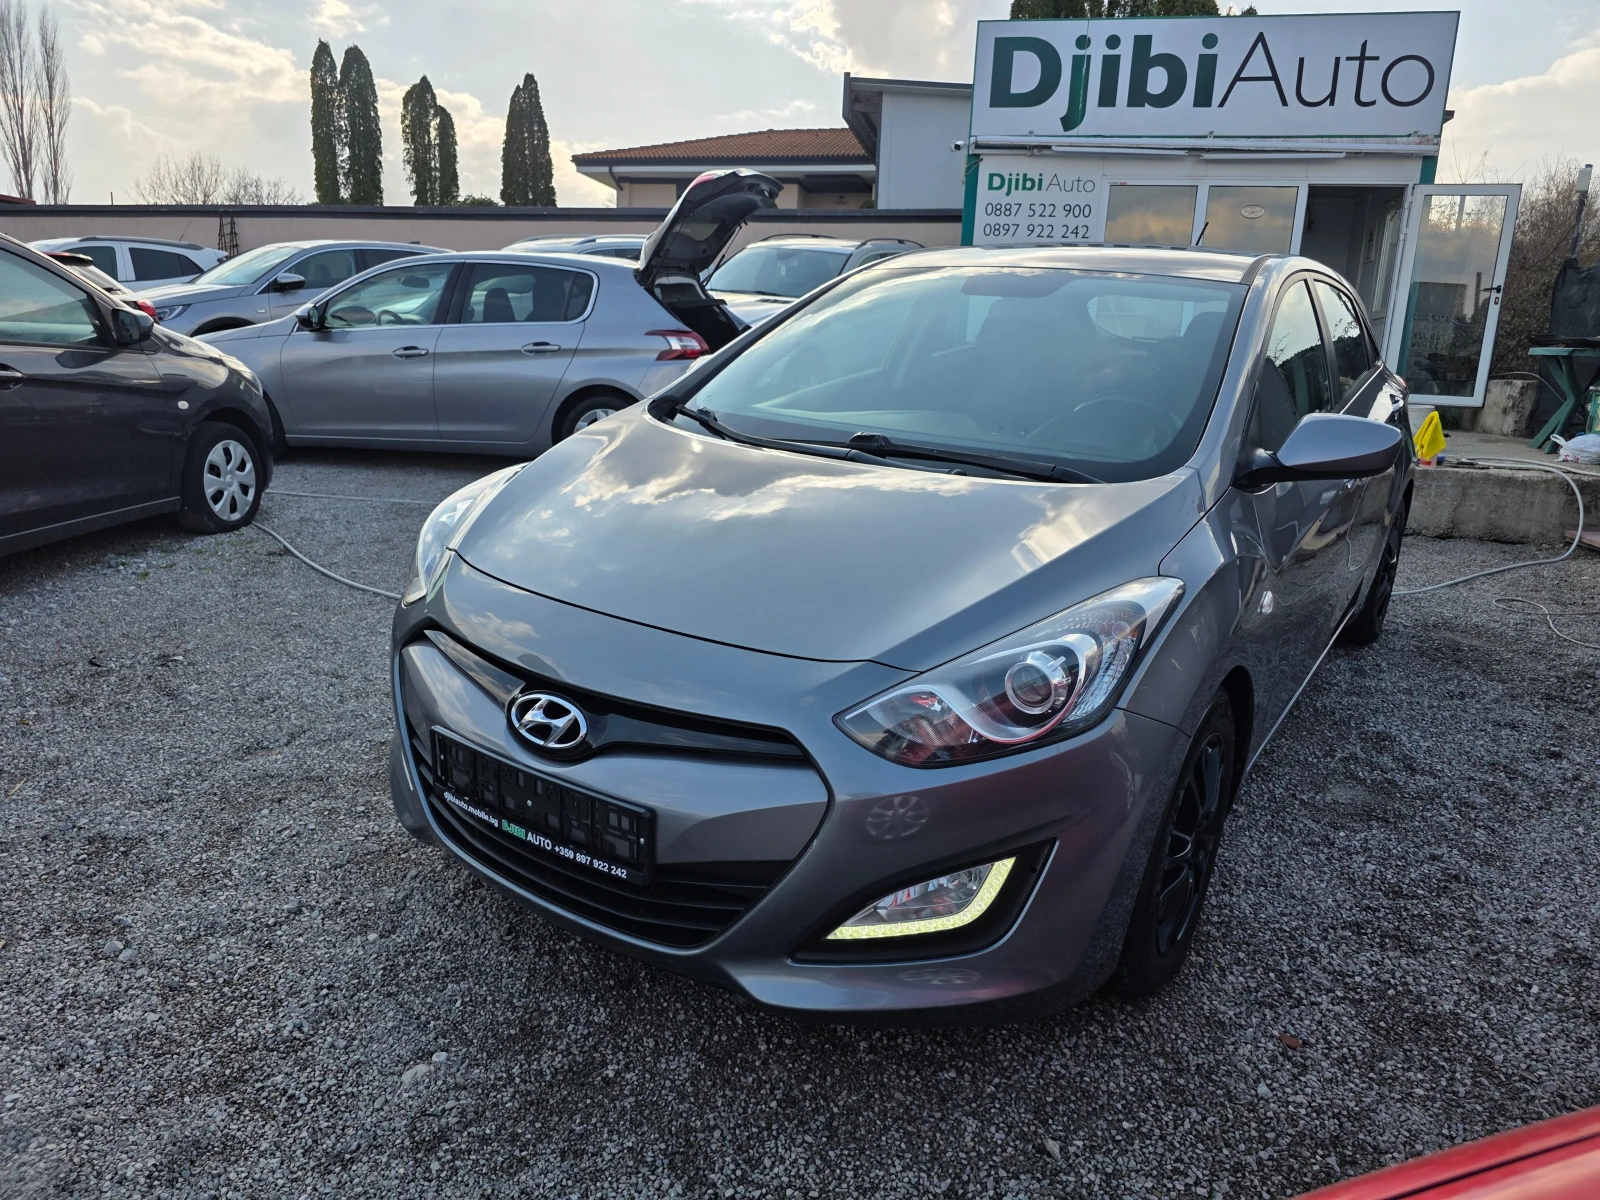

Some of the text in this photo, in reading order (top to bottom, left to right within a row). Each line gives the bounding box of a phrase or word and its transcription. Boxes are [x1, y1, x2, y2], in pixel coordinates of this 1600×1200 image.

[987, 173, 1095, 196] Djibi Auto
[985, 203, 1092, 218] 0887 522 900
[983, 223, 1089, 239] 0897 922 242
[443, 791, 627, 878] djibiauto.mobile.bg DJIBI AUTO +359 897 922 242
